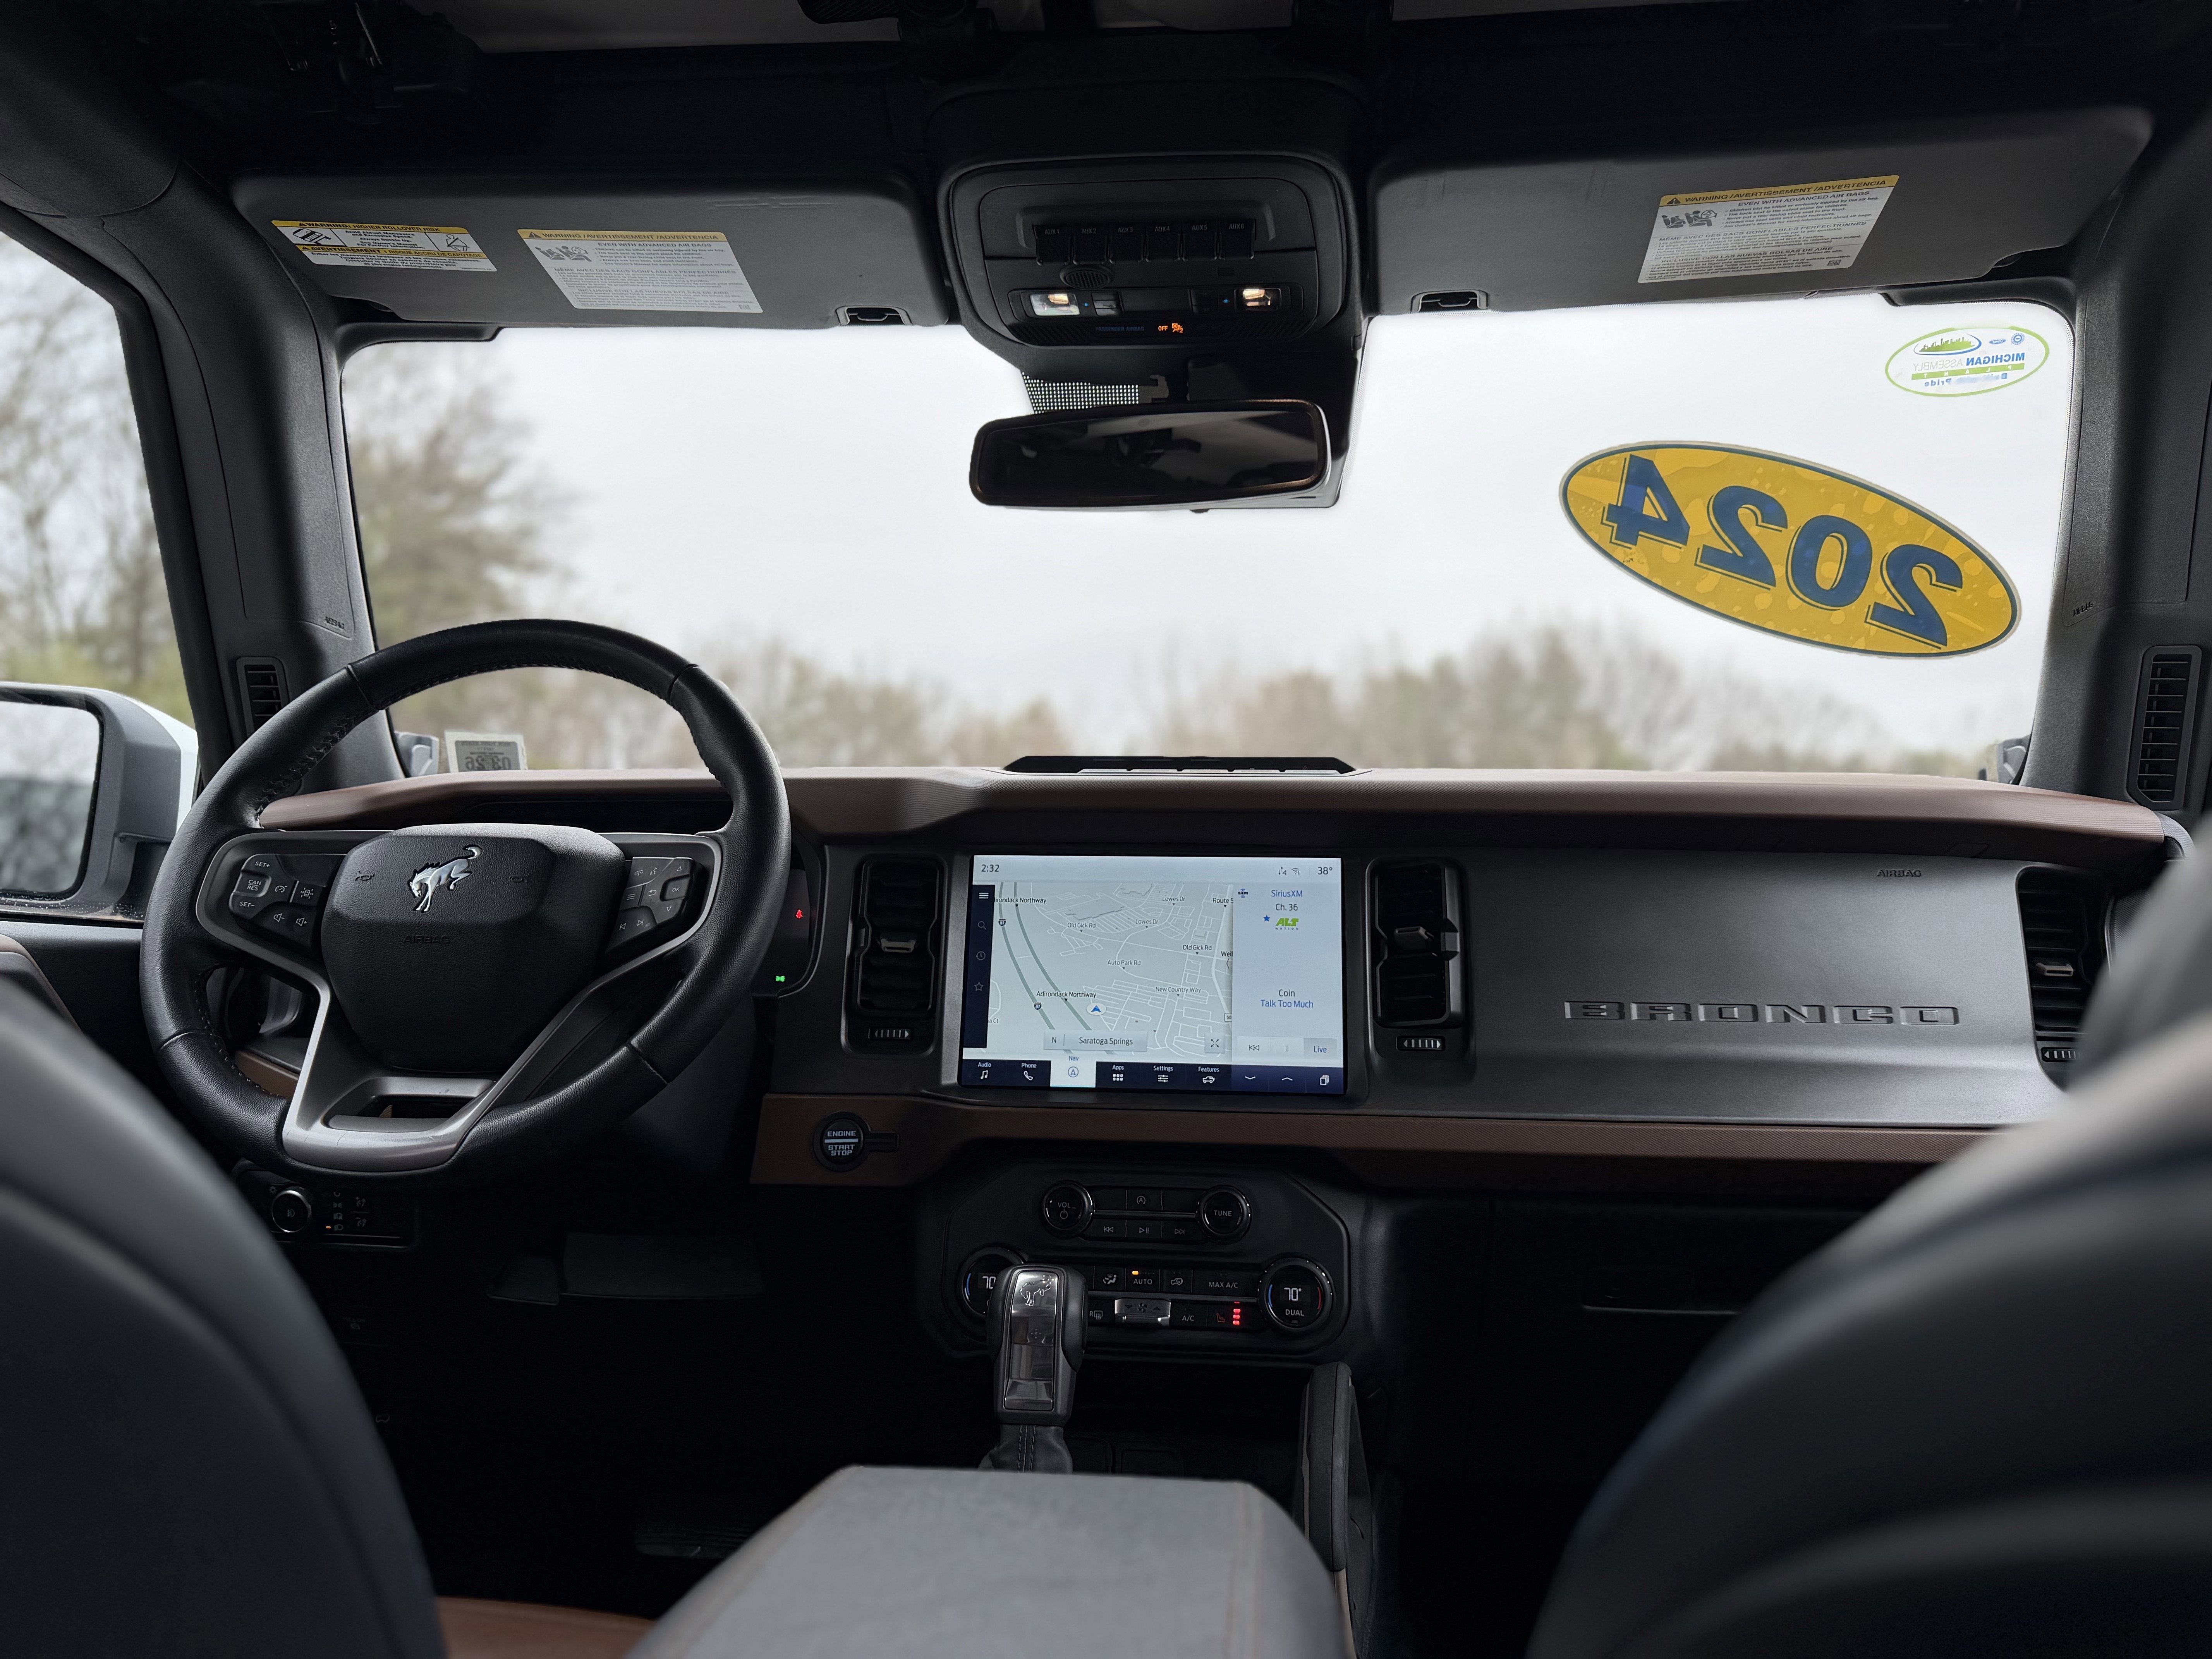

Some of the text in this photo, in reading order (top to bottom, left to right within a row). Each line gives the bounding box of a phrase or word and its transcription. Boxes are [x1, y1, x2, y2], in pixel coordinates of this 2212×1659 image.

[1684, 194, 1729, 202] WARNING
[1317, 867, 1333, 875] 38°
[1877, 869, 1922, 878] AIRBAG
[1275, 918, 1299, 927] ALT
[404, 934, 450, 944] AIRBAG
[1279, 989, 1295, 997] Coin
[1564, 1001, 1960, 1025] BRONCO
[1079, 1037, 1108, 1045] Saratoga
[1284, 1287, 1302, 1301] 70°
